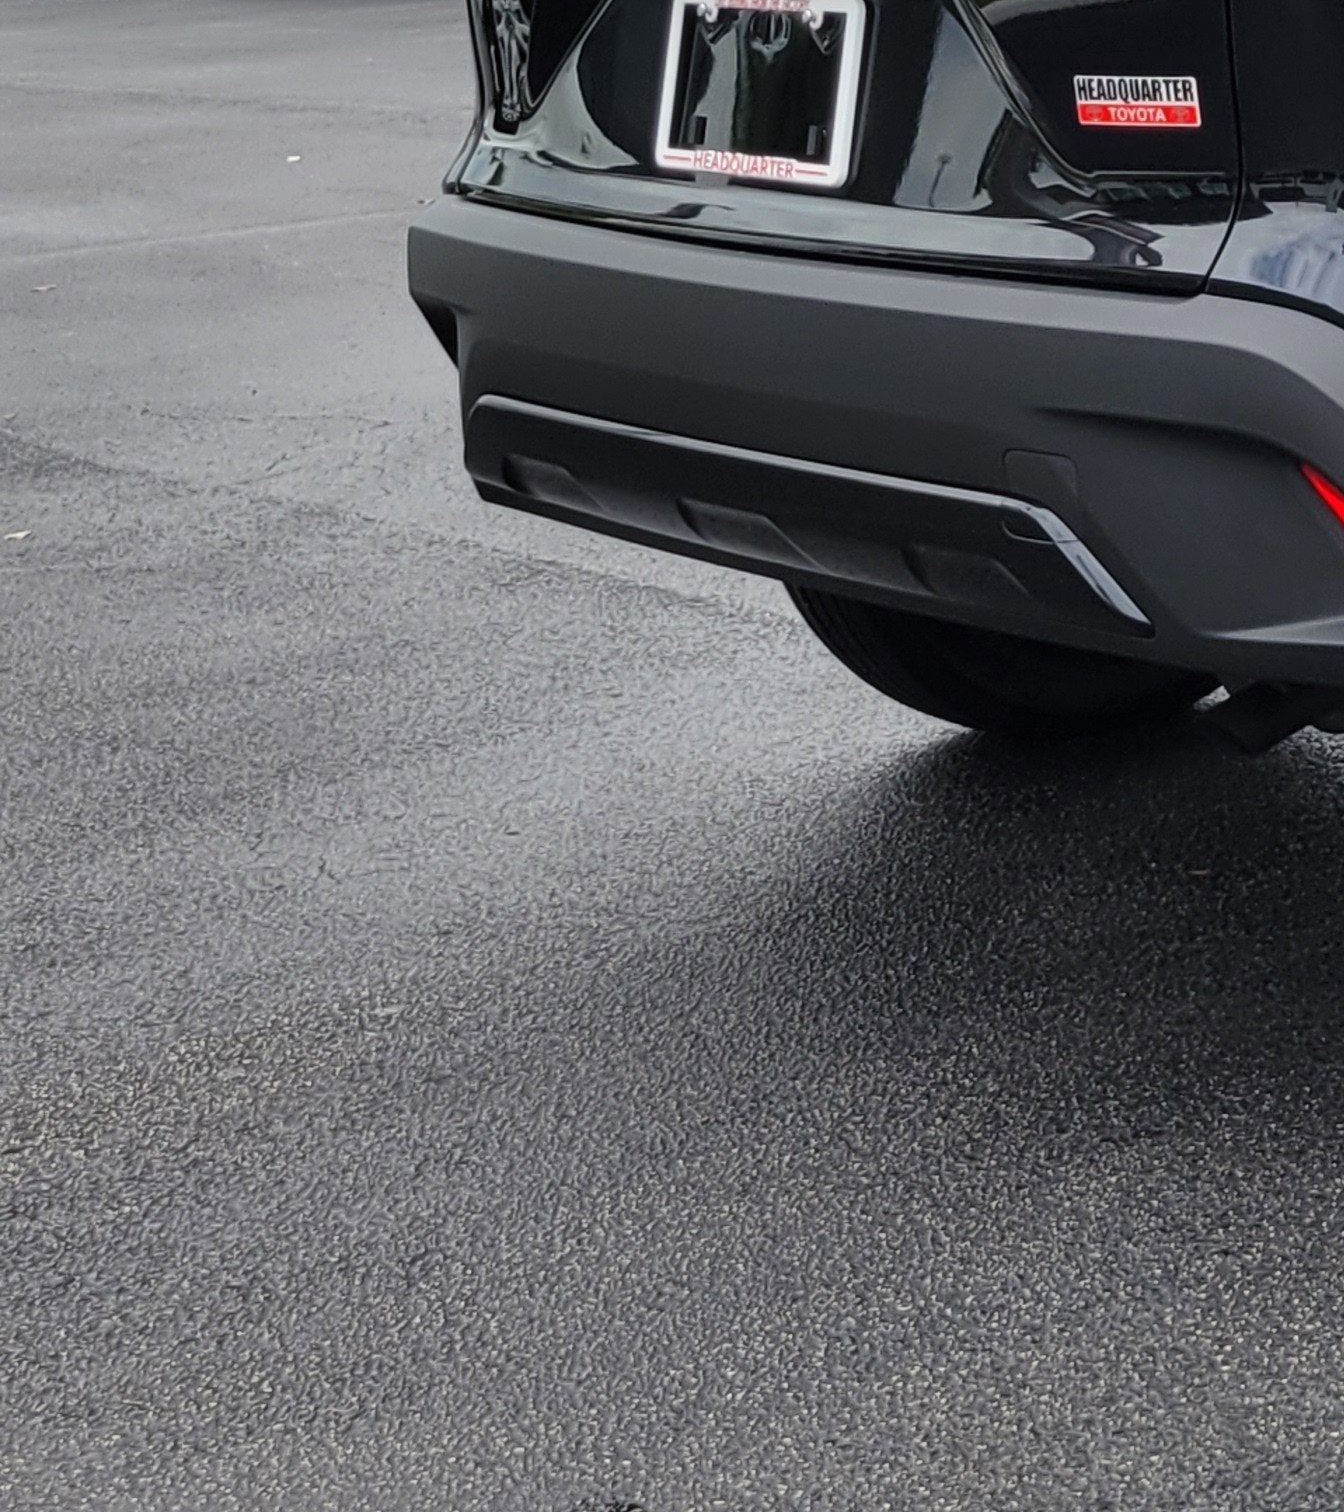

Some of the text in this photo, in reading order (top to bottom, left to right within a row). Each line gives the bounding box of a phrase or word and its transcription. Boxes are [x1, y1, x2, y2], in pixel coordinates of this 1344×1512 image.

[1076, 78, 1195, 104] HEADQUARTER
[1107, 106, 1168, 122] TOYOTA
[692, 154, 795, 180] HEADQUARTER
